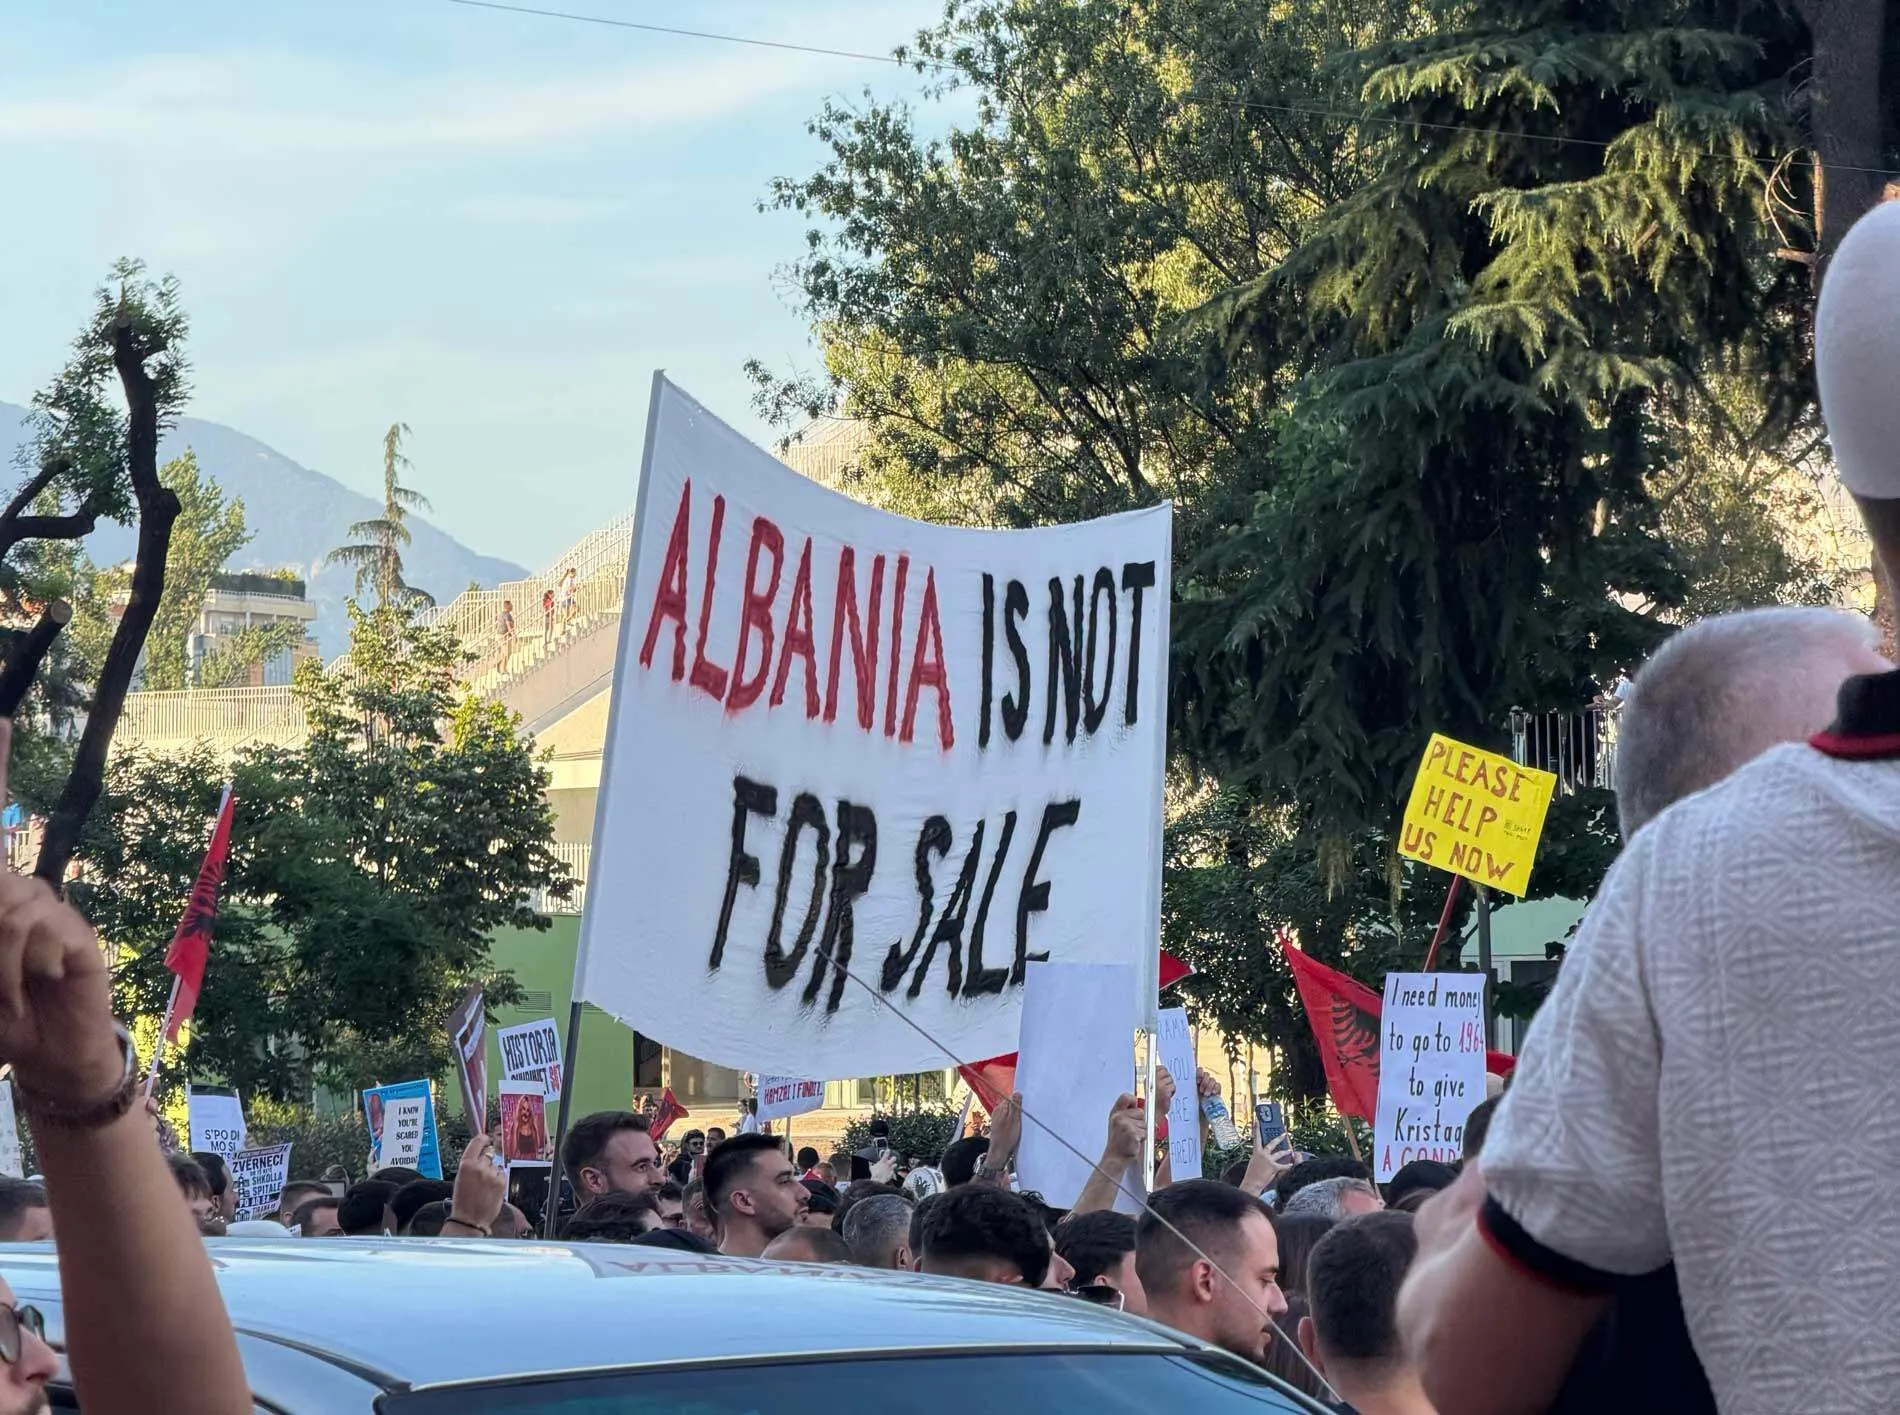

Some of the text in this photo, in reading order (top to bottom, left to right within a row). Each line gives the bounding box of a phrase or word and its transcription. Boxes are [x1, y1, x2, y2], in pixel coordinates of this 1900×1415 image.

[639, 477, 1156, 750] ALBANIA IS NOT
[1426, 740, 1528, 803] PLEASE
[1423, 784, 1498, 838] HELP
[1404, 823, 1515, 881] US NOW
[709, 775, 1081, 1015] FOR SALE
[1391, 976, 1481, 1019] I need money
[502, 1026, 558, 1072] HISTORIA
[1389, 1021, 1404, 1051] to
[1412, 1034, 1430, 1063] go
[1434, 1020, 1452, 1053] to
[1409, 1066, 1465, 1107] to give
[205, 1129, 229, 1140] S'PO
[1382, 1145, 1392, 1173] A
